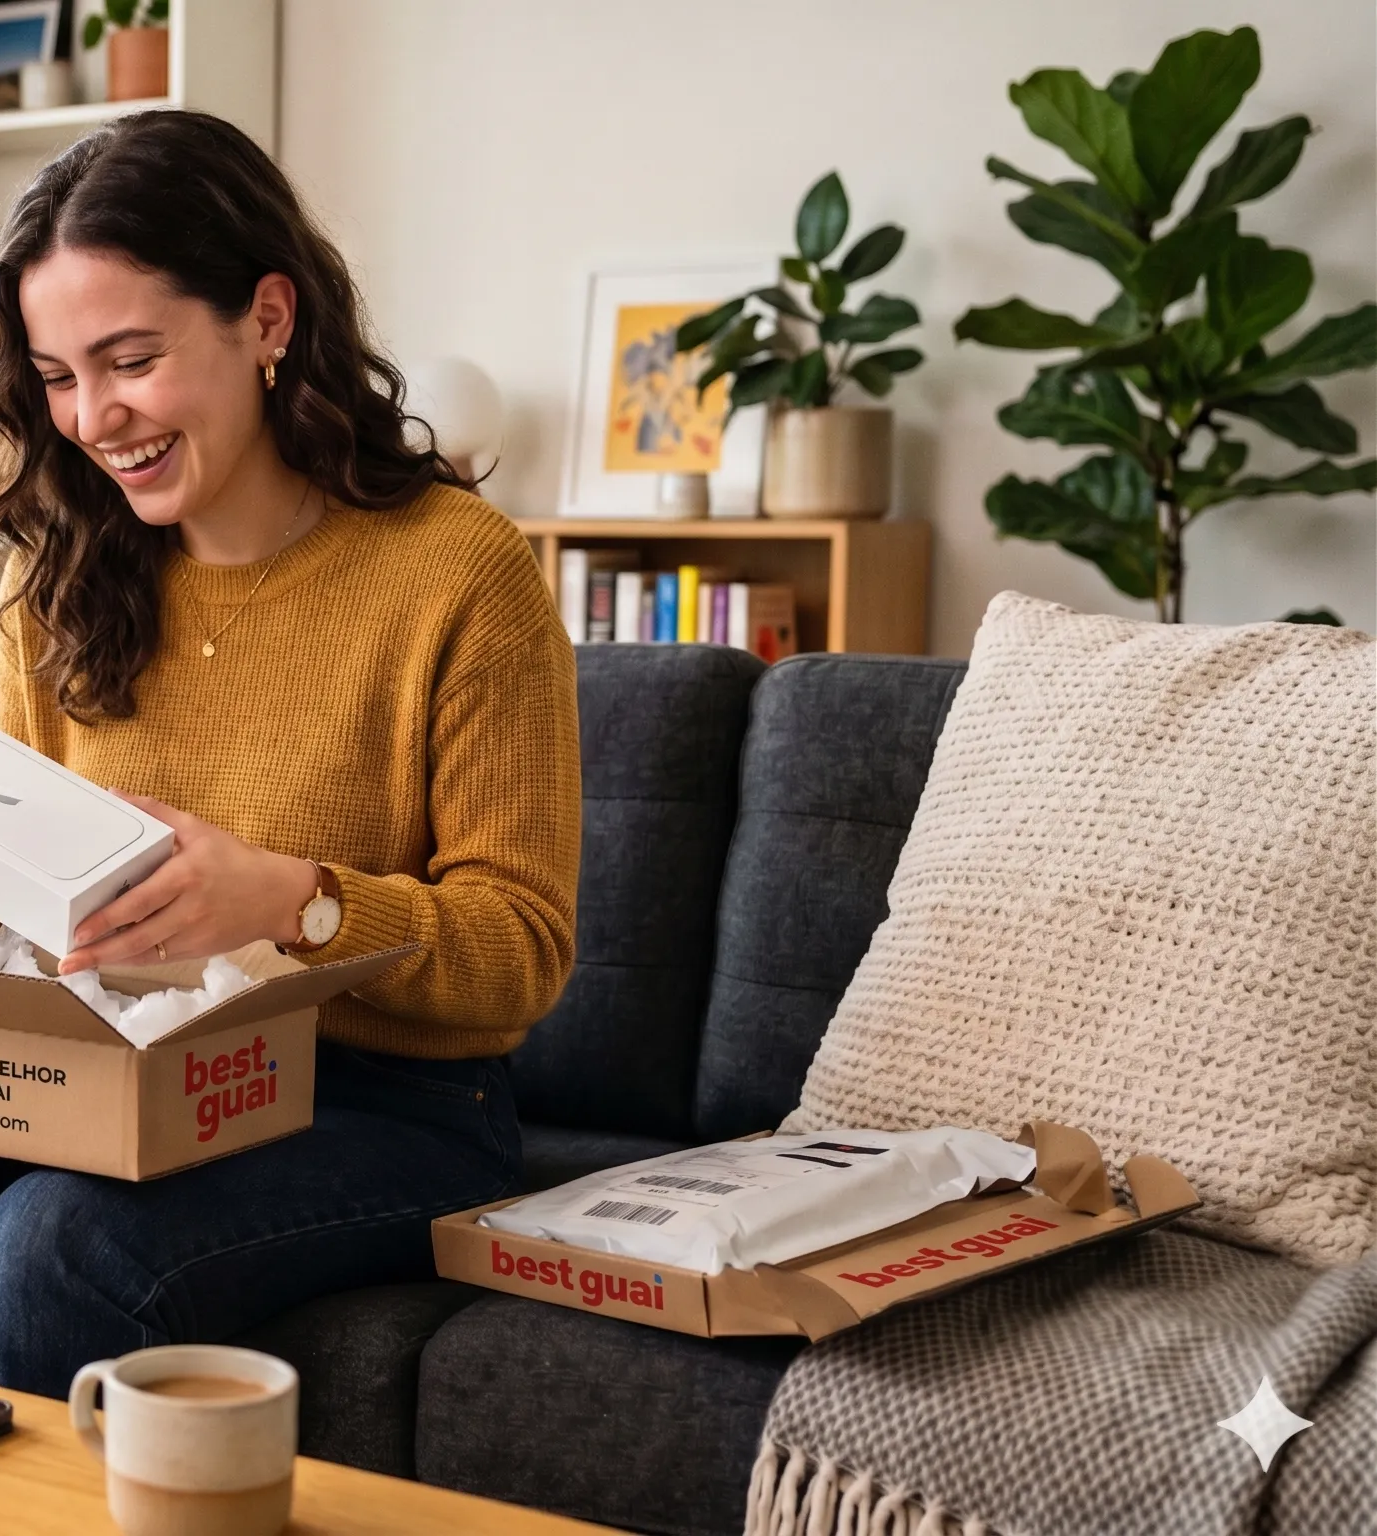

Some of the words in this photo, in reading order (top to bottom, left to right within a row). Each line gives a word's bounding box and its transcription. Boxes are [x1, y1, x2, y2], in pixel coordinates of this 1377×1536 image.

[185, 1035, 266, 1096] best
[197, 1060, 277, 1143] guai
[491, 1240, 574, 1291] best
[579, 1273, 664, 1310] guai
[837, 1247, 969, 1288] best
[951, 1213, 1060, 1258] guai
